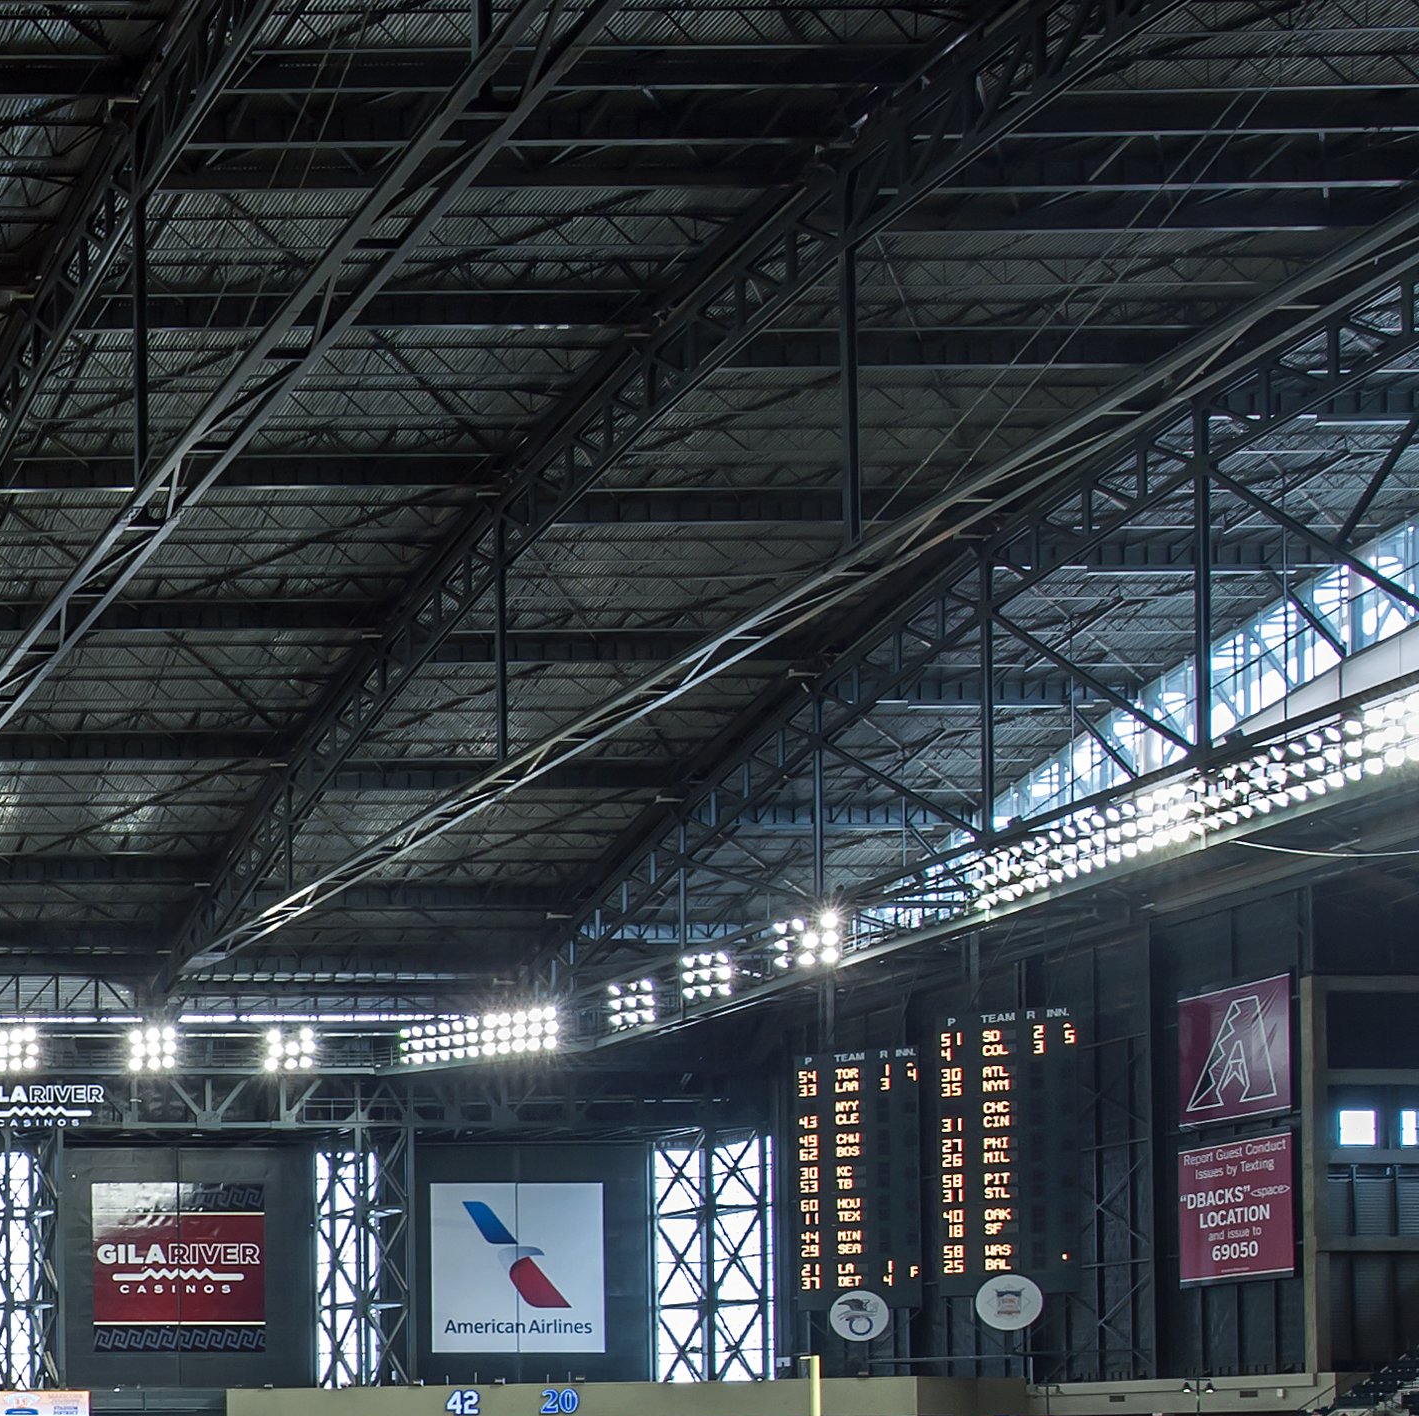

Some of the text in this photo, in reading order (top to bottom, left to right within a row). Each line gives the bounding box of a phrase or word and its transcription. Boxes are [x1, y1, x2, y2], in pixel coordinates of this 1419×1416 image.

[980, 1012, 1016, 1023] TEAM
[983, 1115, 1010, 1128] CIN
[836, 1165, 853, 1177] KC
[1199, 1204, 1270, 1229] LOCATION
[1212, 1241, 1259, 1261] 69050
[119, 1284, 231, 1294] CASINOS
[444, 1318, 593, 1334] American Airlines
[445, 1390, 480, 1415] 42
[540, 1388, 580, 1415] 20
